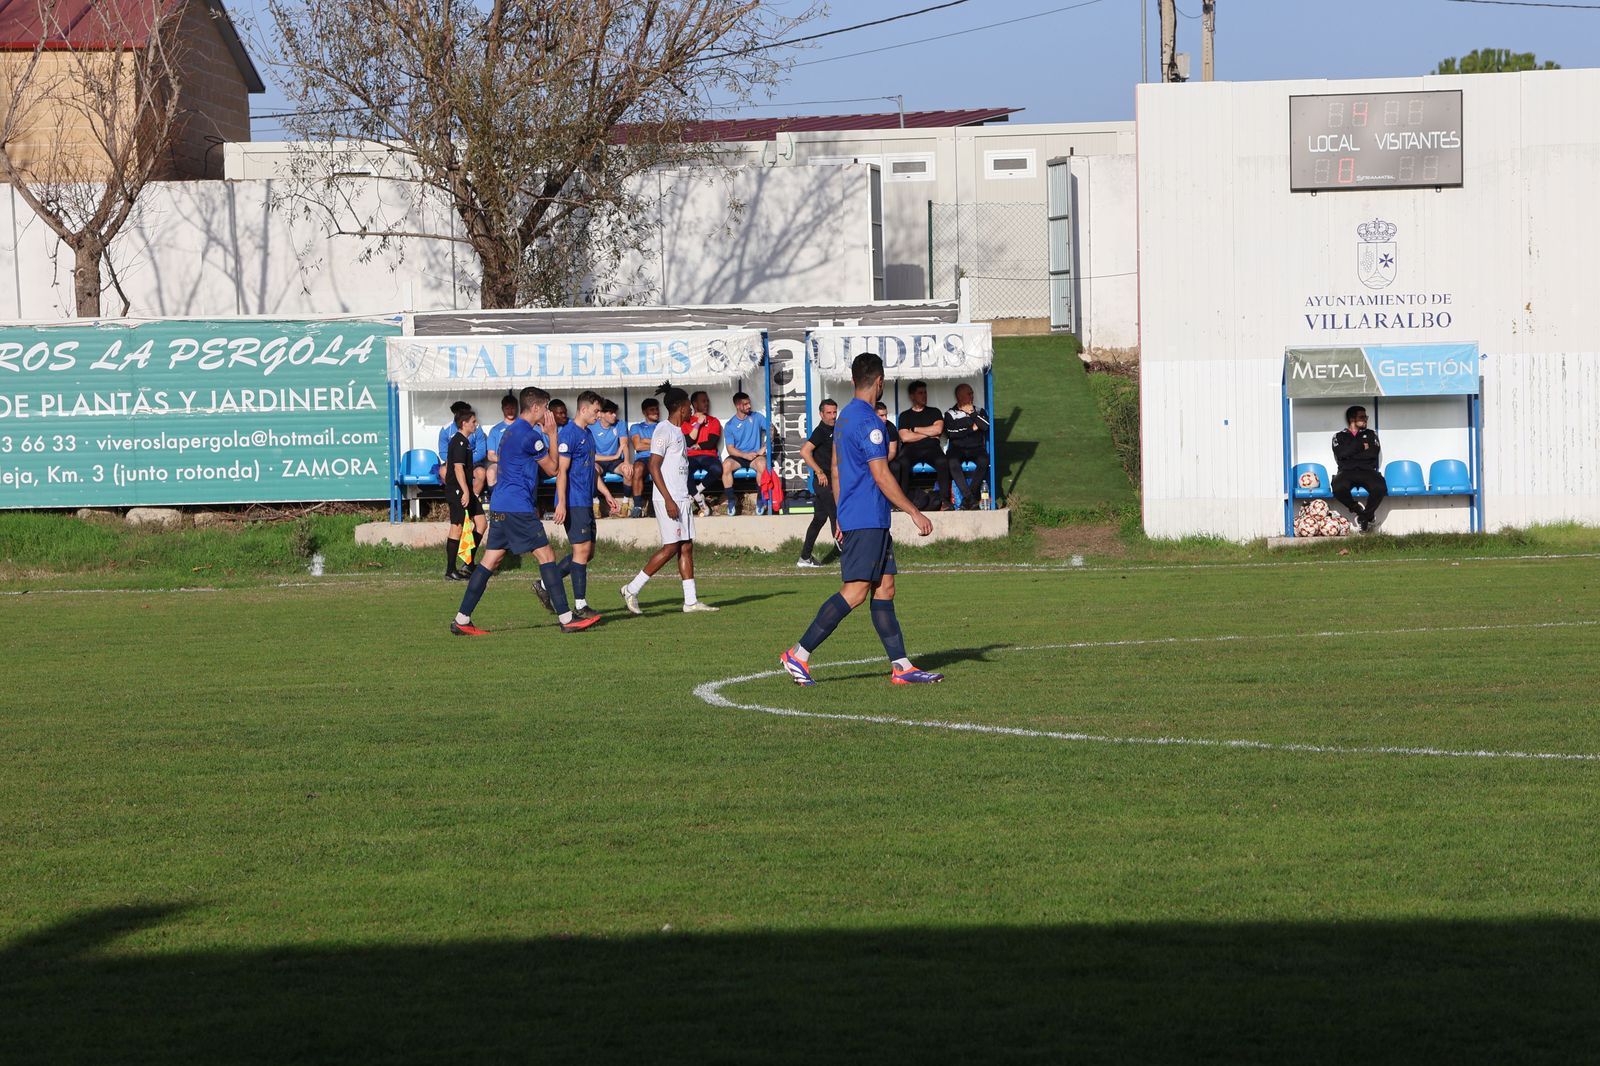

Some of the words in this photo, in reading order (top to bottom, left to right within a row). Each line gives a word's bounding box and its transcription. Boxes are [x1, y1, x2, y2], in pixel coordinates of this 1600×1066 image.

[1308, 134, 1360, 152] LOCAL
[1375, 130, 1461, 150] VISITANTES
[1305, 293, 1427, 307] AYUNTAMIENTO
[1432, 293, 1452, 305] DE
[1304, 311, 1452, 330] VILLARALBO
[89, 339, 154, 371] LA
[168, 334, 375, 376] PERGOLA
[437, 340, 692, 379] TALLERES
[41, 390, 170, 416] PLANTAS
[179, 390, 197, 414] Y
[209, 379, 377, 413] JARDINERÍA
[21, 435, 46, 452] 66
[52, 435, 77, 452] 33
[96, 427, 379, 454] viveroslapergola@hotmail.com
[48, 465, 84, 483] Km.
[92, 464, 105, 483] 3
[113, 463, 169, 487] (junto
[175, 459, 260, 483] rotonda)
[281, 457, 379, 477] ZAMORA
